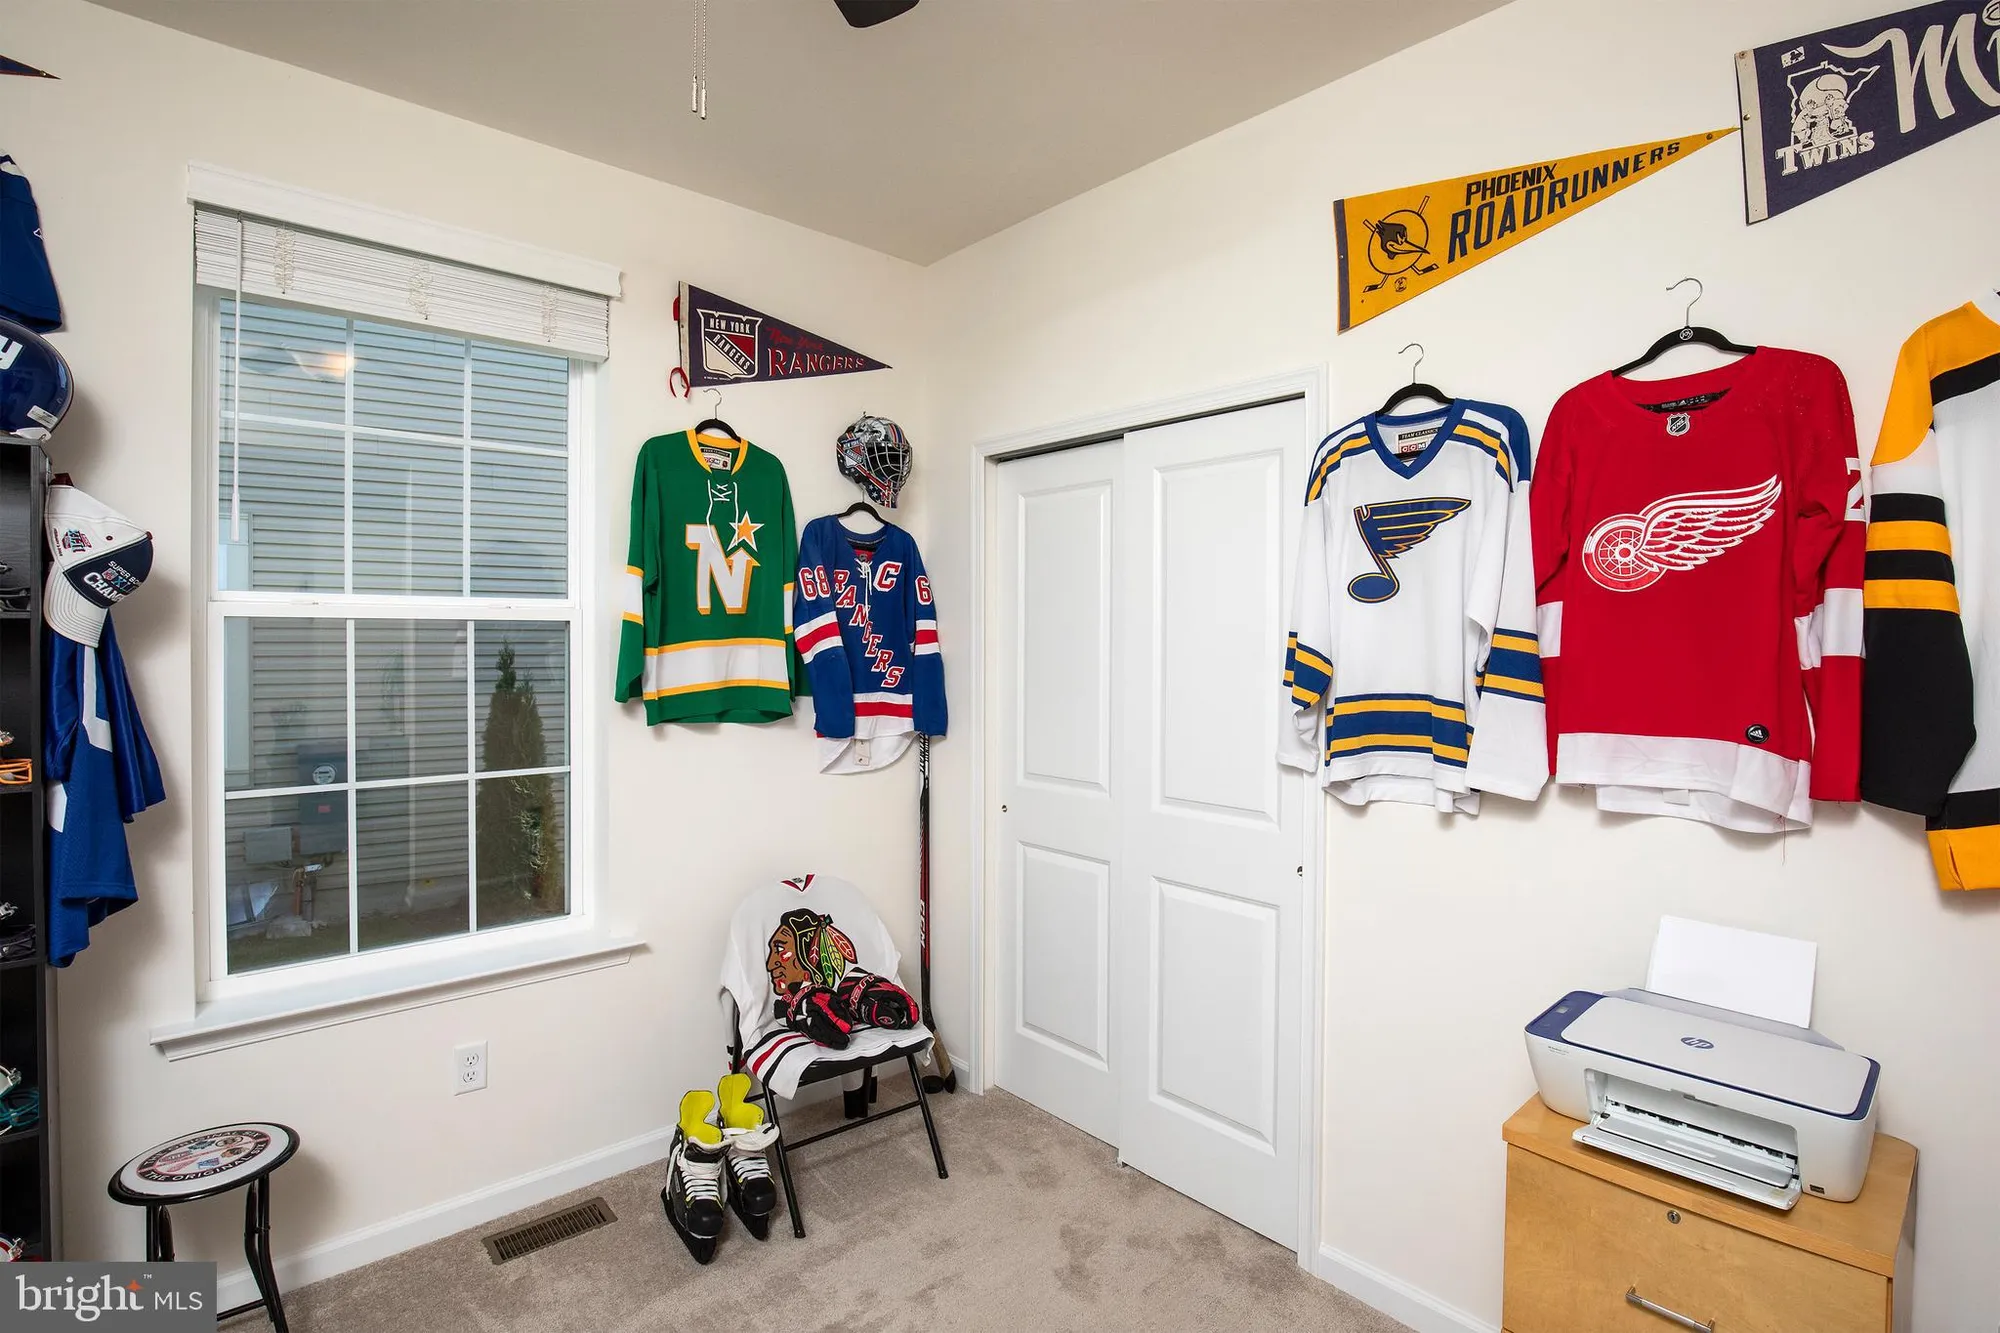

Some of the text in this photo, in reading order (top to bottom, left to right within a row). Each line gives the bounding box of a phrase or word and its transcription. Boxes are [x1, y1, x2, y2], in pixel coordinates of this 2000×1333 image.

[1775, 131, 1876, 177] TWINS
[1465, 163, 1558, 206] PHOENIX
[1447, 142, 1681, 264] ROADRUNNERS
[709, 318, 751, 334] NEW YORK
[713, 334, 751, 371] RANGERS
[767, 347, 865, 377] RANGERS
[1401, 442, 1426, 452] CCM
[107, 560, 132, 579] SUPER
[799, 565, 832, 601] 68
[873, 560, 903, 592] C
[915, 575, 933, 605] 6
[833, 569, 905, 688] RANGERS
[1683, 1037, 1712, 1049] hp
[144, 1171, 168, 1181] THE
[171, 1154, 252, 1181] ORIGINAL
